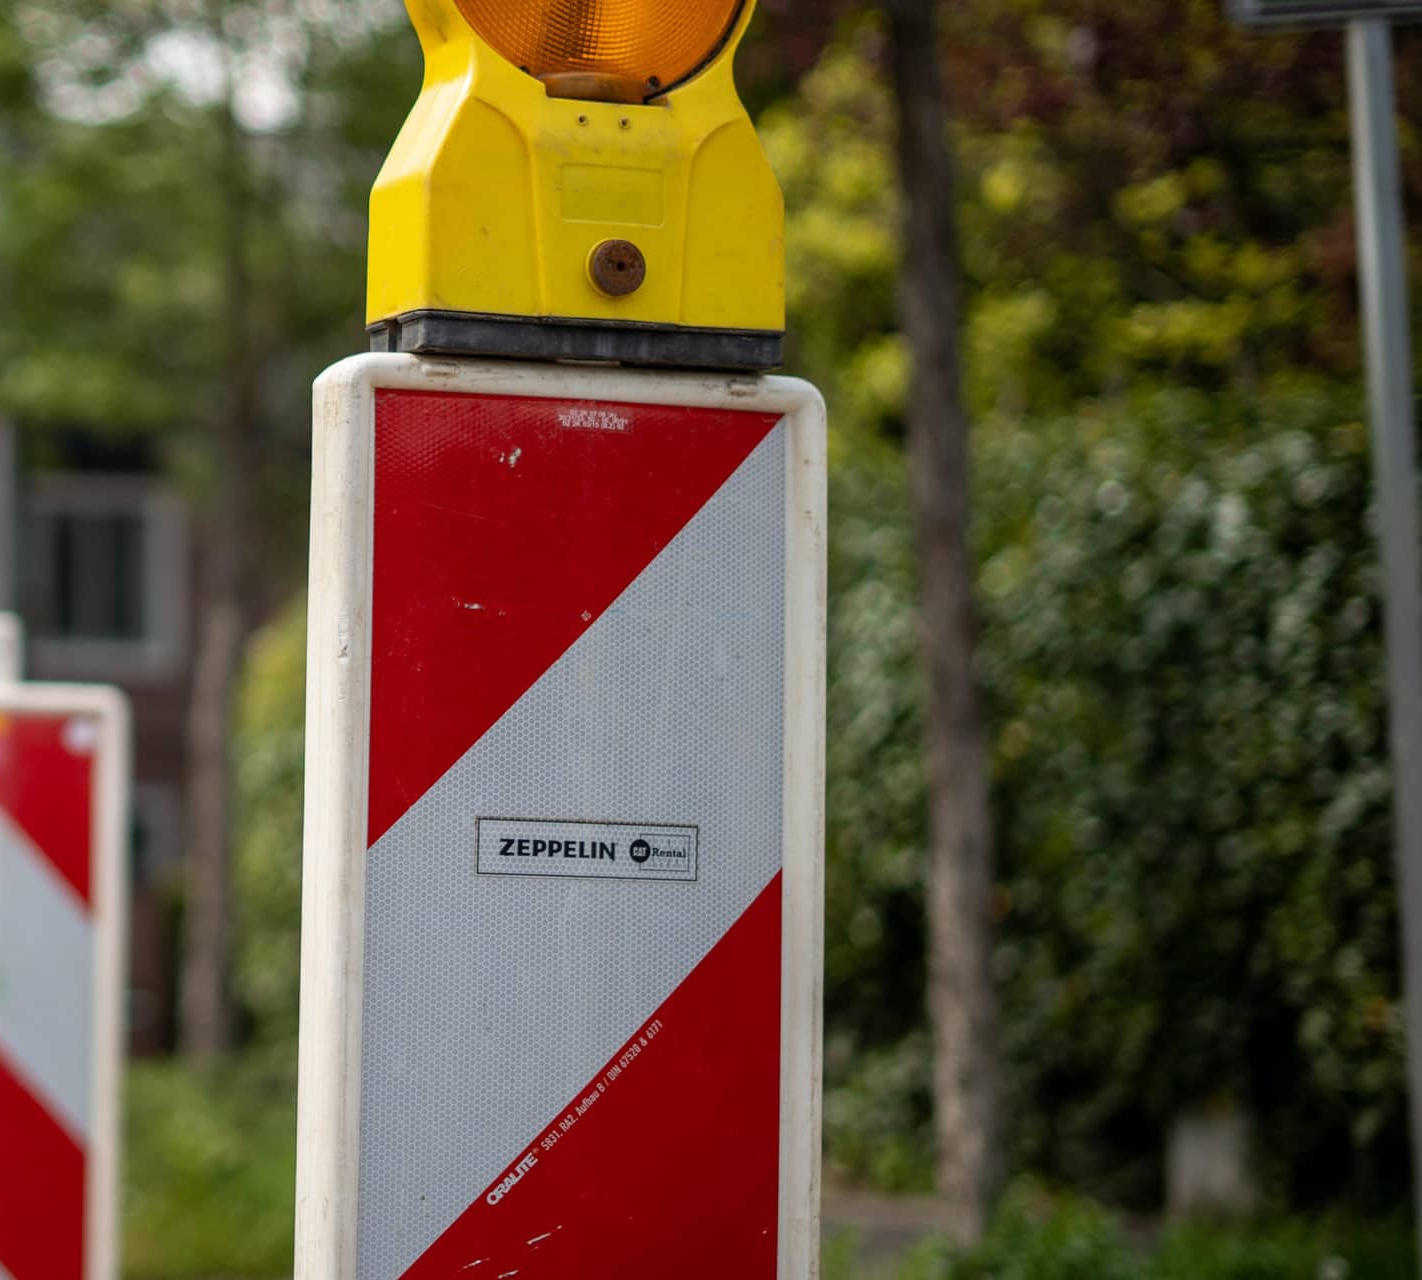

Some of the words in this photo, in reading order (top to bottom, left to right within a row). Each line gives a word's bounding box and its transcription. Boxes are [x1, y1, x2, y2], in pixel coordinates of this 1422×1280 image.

[499, 838, 617, 861] ZEPPELIN
[632, 846, 647, 857] CAT
[652, 847, 687, 858] Rental
[575, 1090, 600, 1117] Aufbau
[596, 1082, 606, 1093] B
[606, 1064, 622, 1081] DIN
[619, 1043, 642, 1068] 67520
[638, 1036, 648, 1047] &
[646, 1019, 663, 1039] 6171
